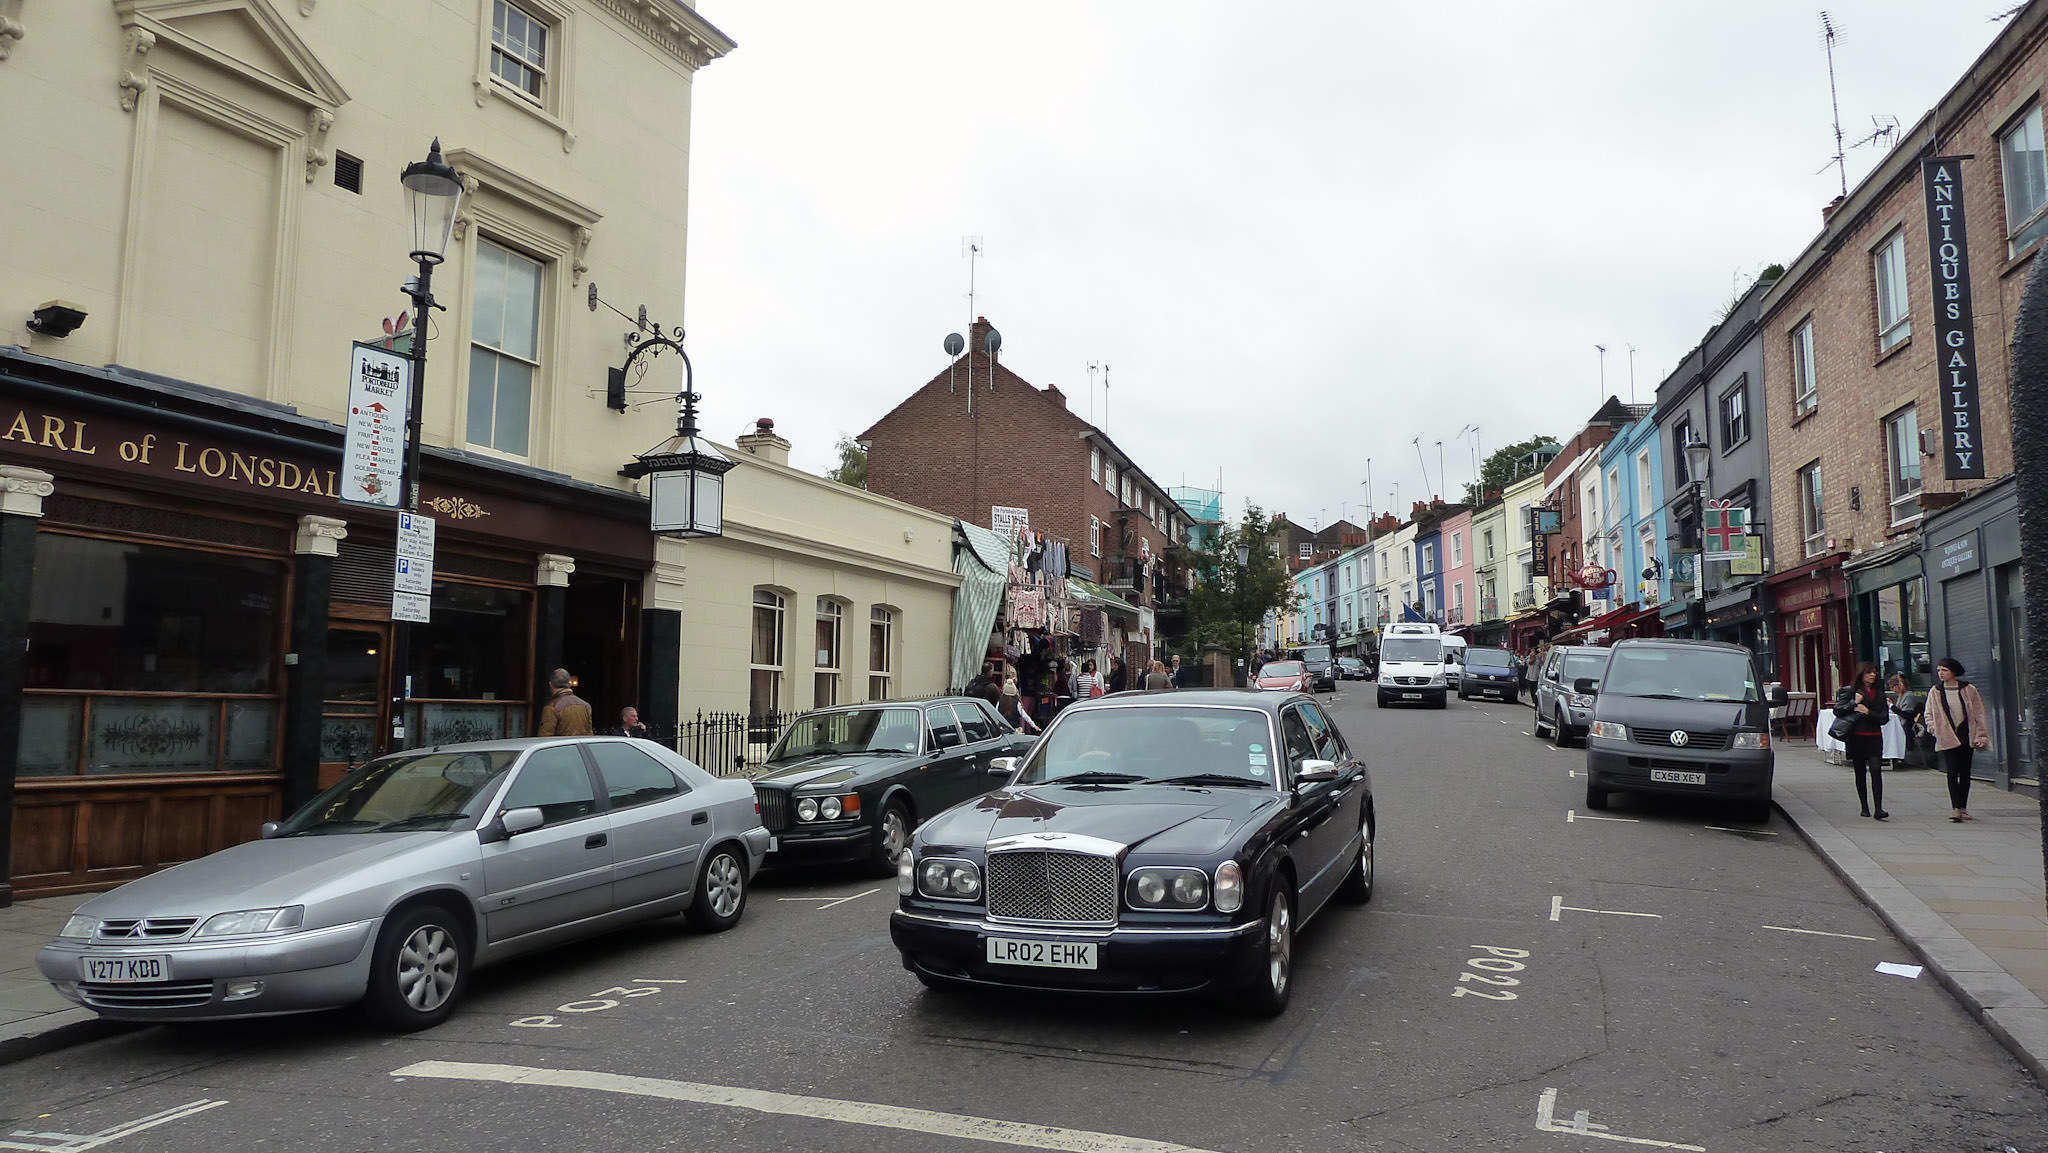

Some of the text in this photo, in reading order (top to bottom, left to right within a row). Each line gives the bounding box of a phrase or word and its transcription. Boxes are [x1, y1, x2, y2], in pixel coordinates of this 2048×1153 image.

[1933, 165, 1973, 470] ANTIQUES GALLERY
[361, 375, 399, 391] PORTOBELLO
[364, 384, 395, 397] MARKET
[360, 409, 389, 421] ANTIQUES
[358, 420, 396, 433] NEW GOODS
[2, 410, 96, 455] ARL
[119, 433, 157, 465] of
[357, 431, 374, 440] FRUIT
[382, 436, 394, 444] VEG
[357, 442, 395, 454] NEW GOODS
[355, 453, 397, 465] FLEA MARKET
[354, 464, 400, 477] GOLBORNE MKT
[994, 514, 1011, 524] STALLS
[1535, 534, 1545, 561] GOLD
[1682, 773, 1701, 783] XEY
[995, 941, 1089, 965] LR02 EHK
[89, 959, 160, 979] V277 KDD
